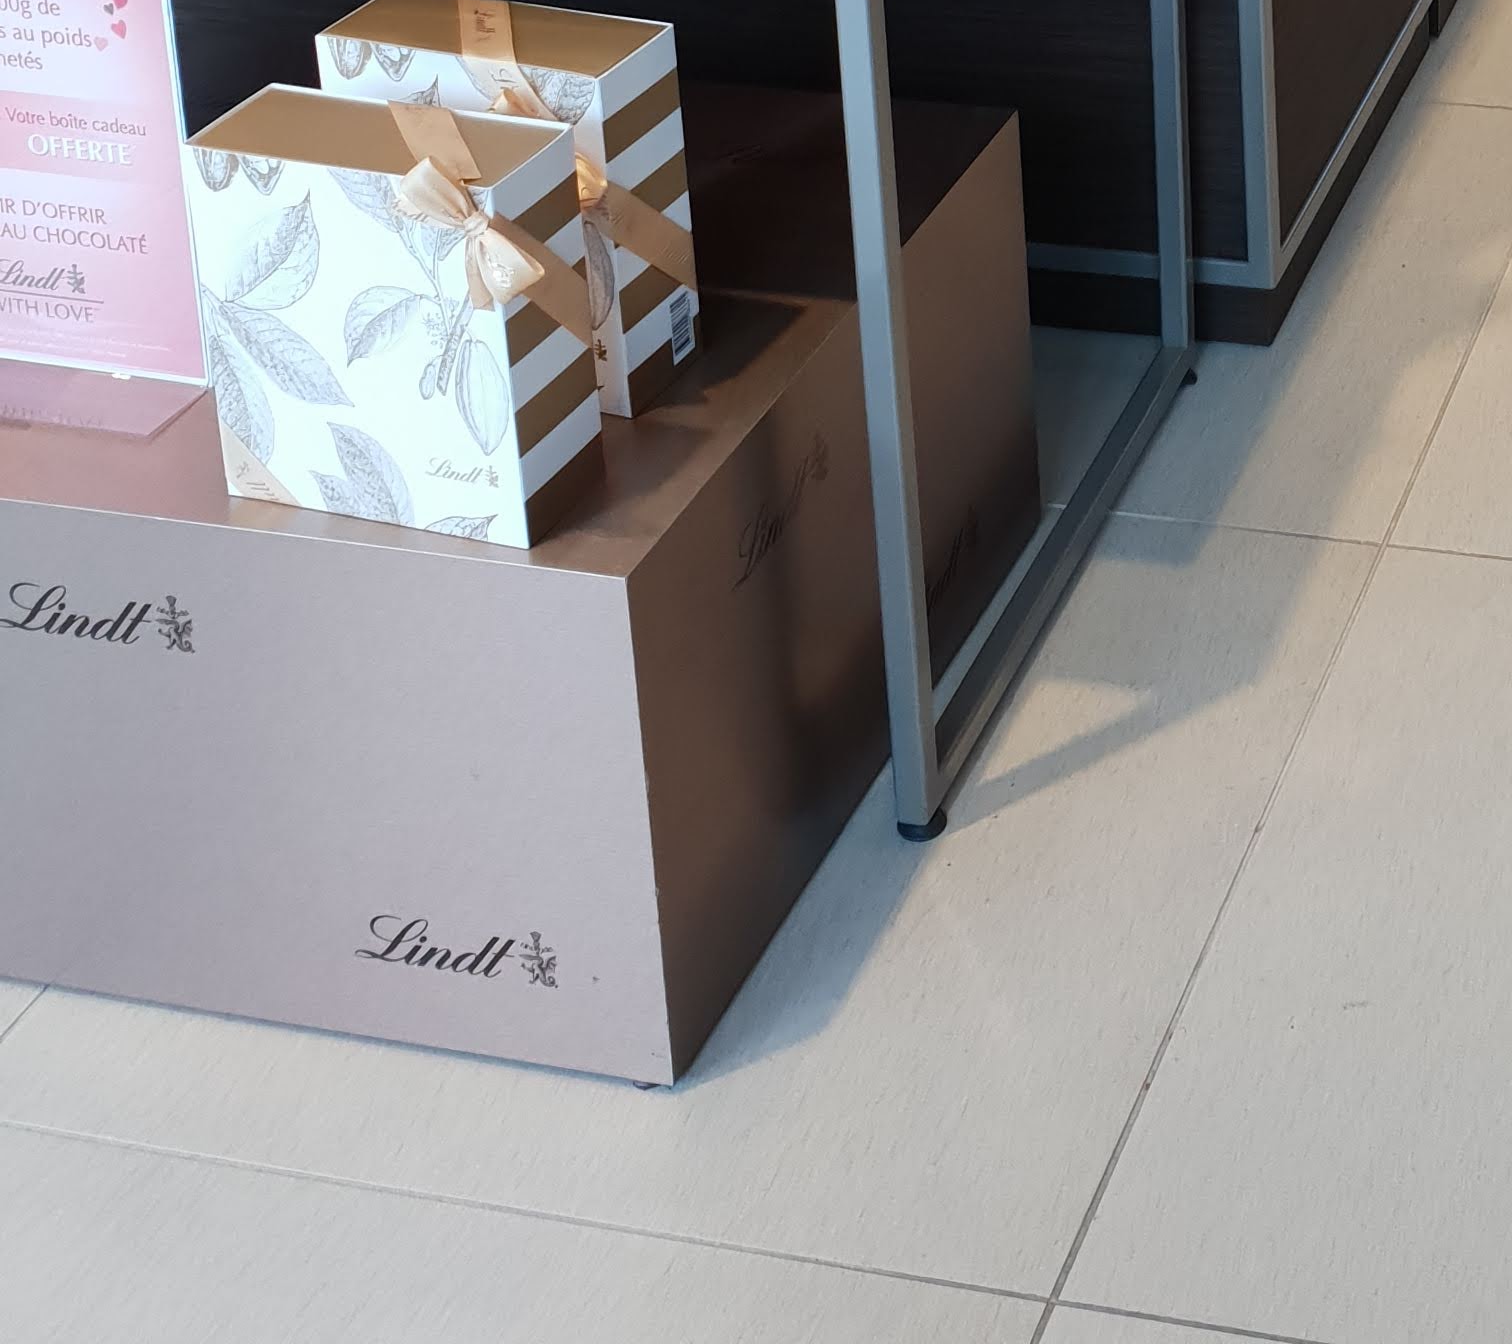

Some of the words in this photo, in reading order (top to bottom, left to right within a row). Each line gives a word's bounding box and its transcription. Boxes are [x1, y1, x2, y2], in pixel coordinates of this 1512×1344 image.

[13, 26, 35, 42] au
[41, 26, 92, 48] poids
[5, 106, 45, 125] Votre
[49, 111, 88, 130] boîte
[92, 118, 147, 136] cadeau
[27, 133, 133, 166] OFFERTE
[33, 225, 148, 255] CHOCOLATÉ
[45, 301, 95, 323] LOVE
[425, 457, 484, 483] Lindt
[0, 583, 152, 644] Lindt
[354, 914, 516, 978] Lindt
